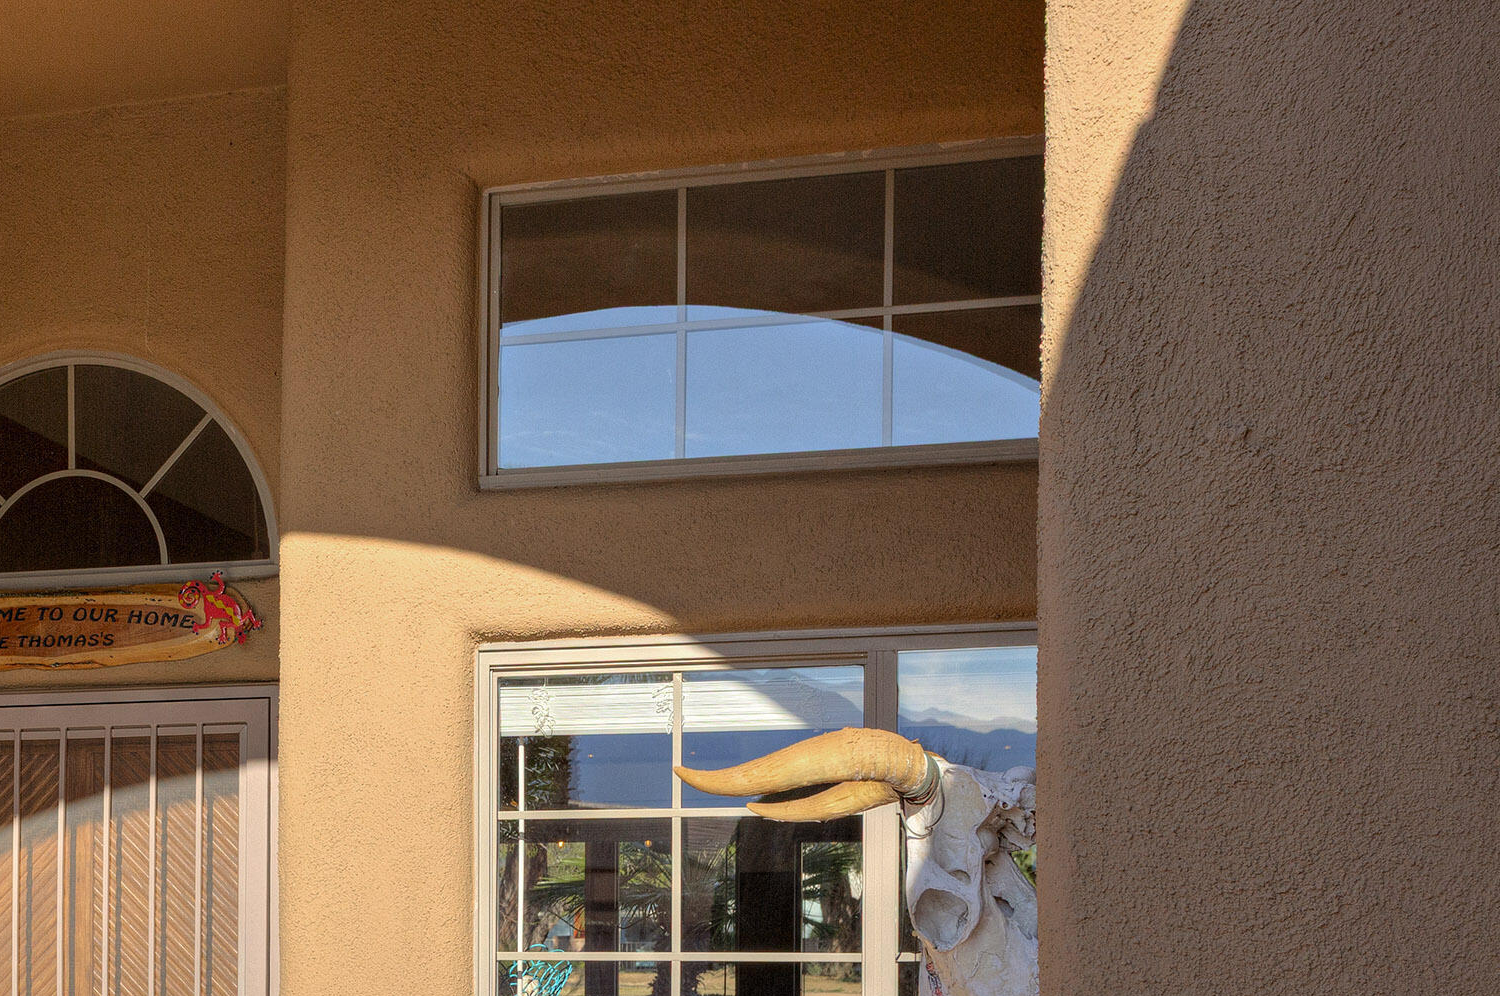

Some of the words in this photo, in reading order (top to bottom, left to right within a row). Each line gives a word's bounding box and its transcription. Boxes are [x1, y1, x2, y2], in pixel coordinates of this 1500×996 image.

[37, 607, 63, 622] TO
[72, 607, 118, 623] OUR
[126, 609, 194, 630] HOME
[18, 632, 115, 650] THOMAS'S
